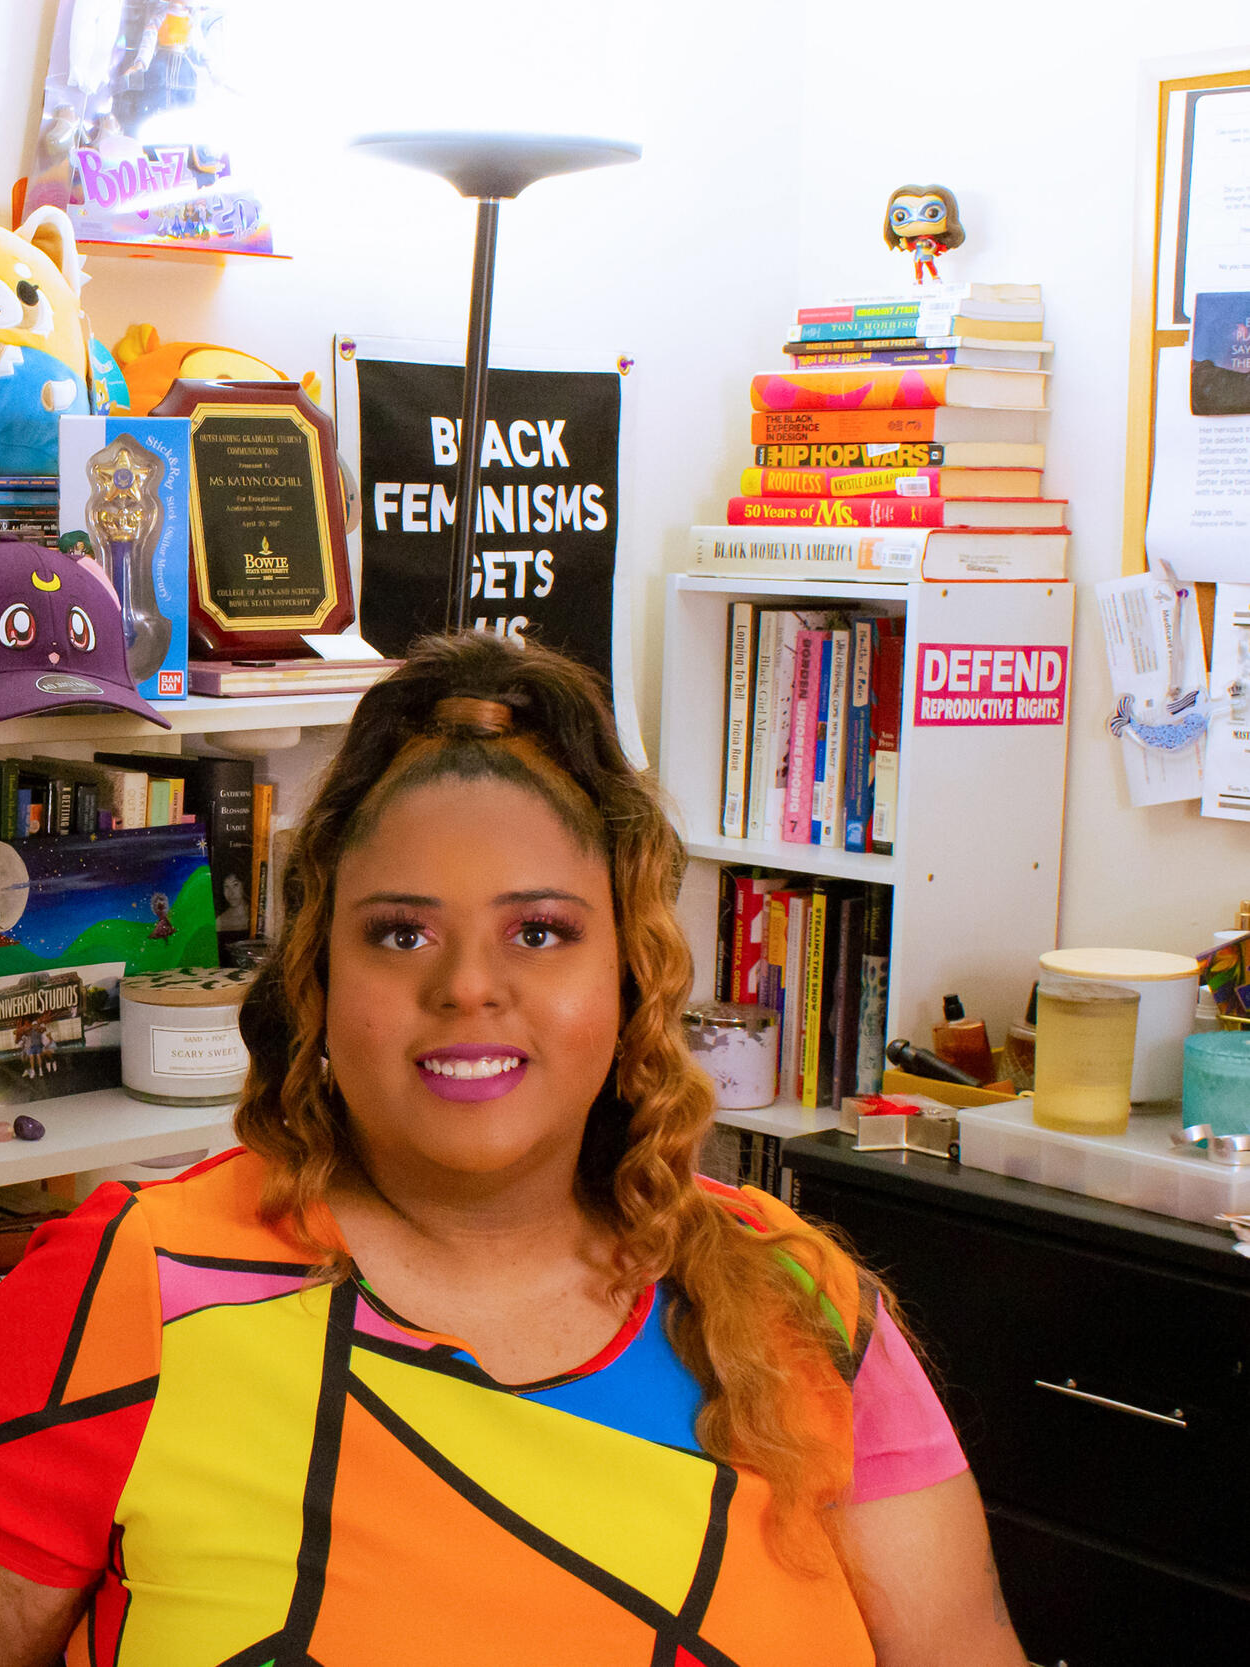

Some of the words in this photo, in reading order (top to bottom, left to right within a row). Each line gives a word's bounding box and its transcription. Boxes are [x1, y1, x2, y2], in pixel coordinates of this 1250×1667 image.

[831, 321, 859, 332] TONI
[766, 415, 783, 424] THE
[784, 414, 813, 424] BLACK
[766, 423, 820, 432] EXPERIENCE
[430, 416, 571, 468] BACK
[766, 432, 774, 441] IN
[776, 432, 808, 441] DESIGN
[775, 445, 809, 467] HIP
[810, 444, 860, 466] HOP
[862, 444, 930, 467] WARS
[209, 476, 226, 487] MS.
[767, 471, 822, 493] ROOTLESS
[744, 504, 760, 518] 50
[762, 503, 797, 518] Years
[799, 503, 814, 518] of
[814, 500, 859, 526] Ms.
[244, 554, 289, 569] BOWIE
[713, 541, 747, 560] BLACK
[749, 542, 787, 561] WOMEN
[789, 543, 802, 561] IN
[734, 624, 748, 666] Longing
[161, 674, 181, 683] BAN
[735, 669, 747, 681] to
[759, 654, 771, 687] Black
[798, 638, 813, 700] BORDEN
[921, 649, 1063, 692] DEFEND
[161, 683, 177, 691] DAI
[734, 683, 747, 700] Tell
[856, 677, 867, 700] Rain
[757, 689, 769, 714] Girl
[920, 696, 1013, 720] REPRODUCTIVE
[1015, 697, 1061, 720] RIGHTS
[732, 718, 744, 745] Tricia
[754, 718, 768, 754] Magic
[730, 748, 743, 771] Rose
[790, 700, 806, 813] WHOREPHOBIA
[812, 906, 822, 959] STEALING
[811, 958, 820, 980] THE
[38, 984, 79, 1014] STUDIOS
[810, 982, 819, 1012] SHOW
[170, 1050, 204, 1058] SCARY
[207, 1046, 238, 1057] SWEET
